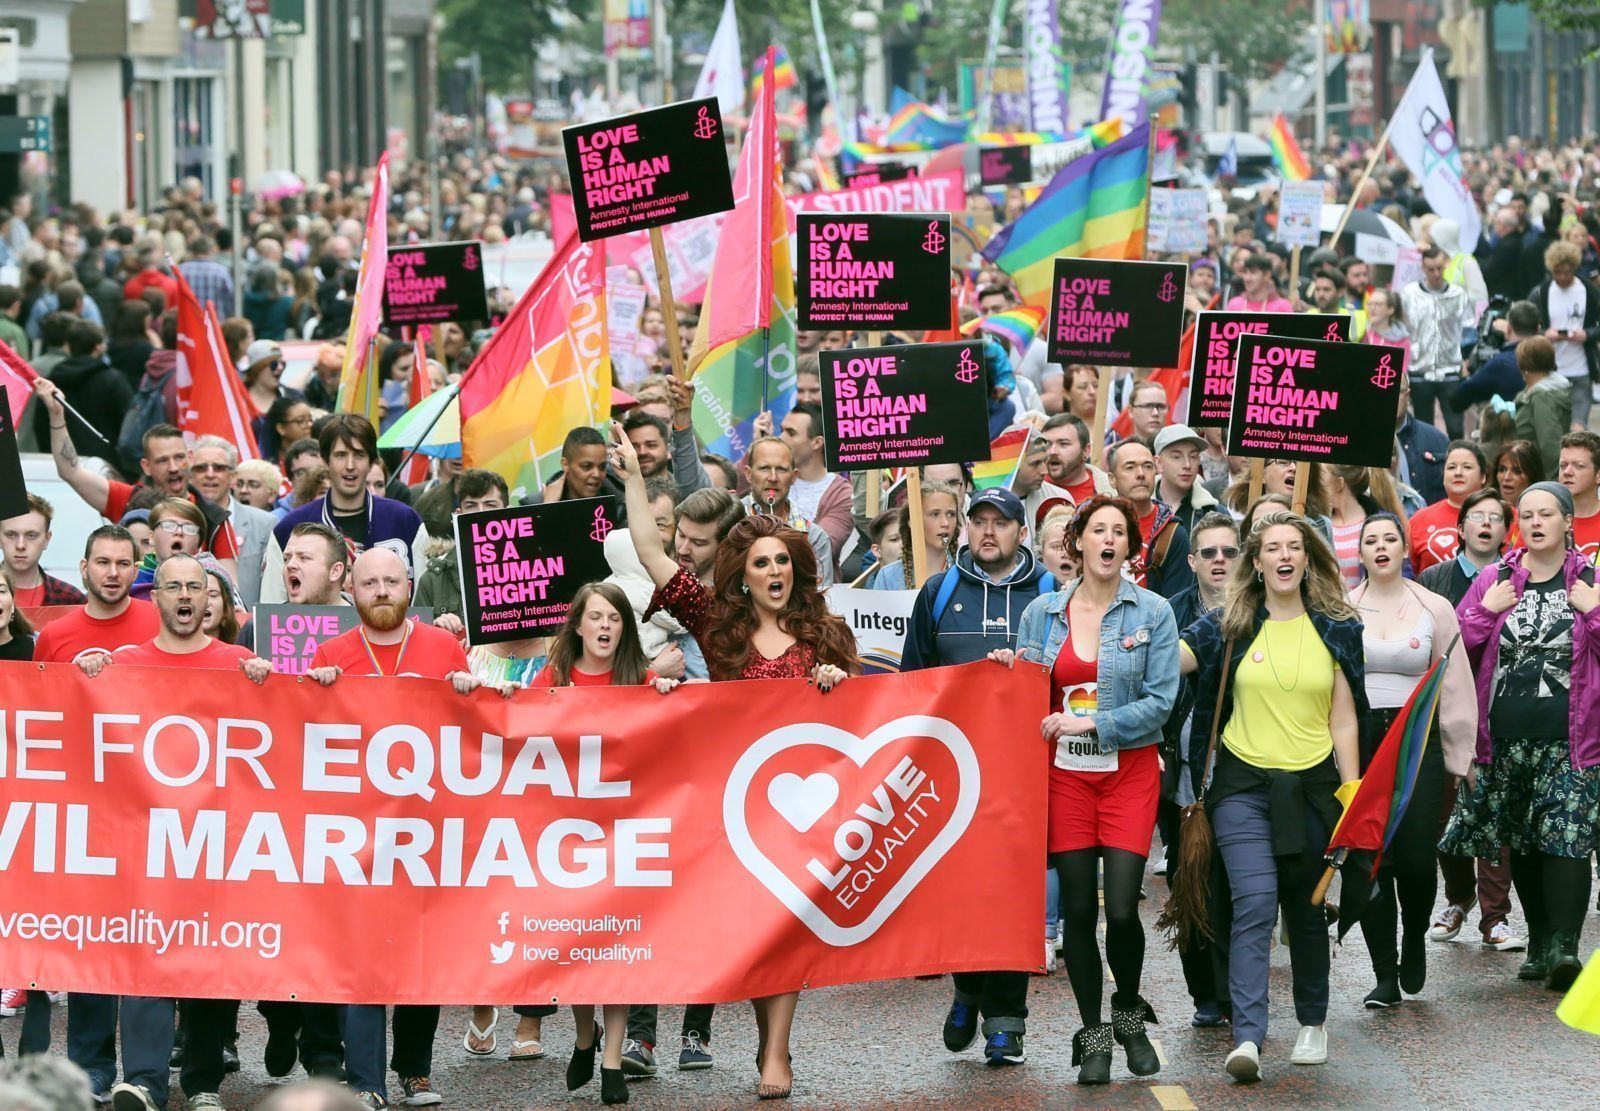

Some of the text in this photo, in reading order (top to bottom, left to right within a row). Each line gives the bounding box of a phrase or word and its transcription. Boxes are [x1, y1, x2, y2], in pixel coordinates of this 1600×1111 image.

[577, 124, 639, 153] LOVE
[580, 147, 626, 171] IS A
[583, 155, 670, 190] HUMAN
[586, 177, 656, 209] RIGHT
[813, 178, 950, 213] STUDENT
[590, 191, 689, 221] Amnesty International
[591, 206, 676, 231] PROTECT THE HUMAN
[809, 223, 869, 241] LOVE
[810, 242, 853, 260] IS A
[404, 266, 416, 279] A
[810, 261, 894, 279] HUMAN
[387, 276, 447, 292] HUMAN
[810, 280, 879, 298] RIGHT
[1060, 277, 1111, 295] LOVE
[389, 289, 436, 305] RIGHT
[810, 302, 908, 312] Amnesty International
[1059, 294, 1095, 310] IS A
[1058, 310, 1129, 328] HUMAN
[1056, 326, 1115, 344] RIGHT
[1056, 348, 1130, 359] Amnesty International
[1208, 341, 1229, 359] IS
[1253, 345, 1316, 368] LOVE
[833, 356, 897, 379] LOVE
[1250, 366, 1273, 385] IS
[1277, 368, 1296, 387] A
[835, 378, 881, 399] IS A
[1247, 385, 1339, 410] HUMAN
[836, 394, 926, 419] HUMAN
[1245, 405, 1320, 428] RIGHT
[838, 415, 911, 439] RIGHT
[1244, 427, 1348, 445] Amnesty International
[839, 435, 944, 452] Amnesty International
[1242, 440, 1331, 454] PROTECT THE HUMAN
[839, 449, 929, 462] PROTECT THE HUMAN
[472, 517, 534, 543] LOVE
[474, 541, 520, 564] IS A
[476, 556, 565, 585] HUMAN
[478, 580, 550, 607] RIGHT
[271, 614, 339, 636] LOVE
[481, 608, 522, 621] Amnesty
[481, 621, 518, 633] PROTECT
[520, 619, 537, 628] THE
[271, 635, 318, 656] IS A
[93, 713, 276, 790] FOR
[302, 722, 631, 803] EQUAL
[1068, 741, 1103, 757] EQUA
[805, 754, 927, 892] LOVE
[146, 807, 672, 889] MARRIAGE
[836, 780, 941, 910] EQUALITY
[523, 915, 641, 936] loveequalityni
[523, 943, 652, 965] love_equalityni
